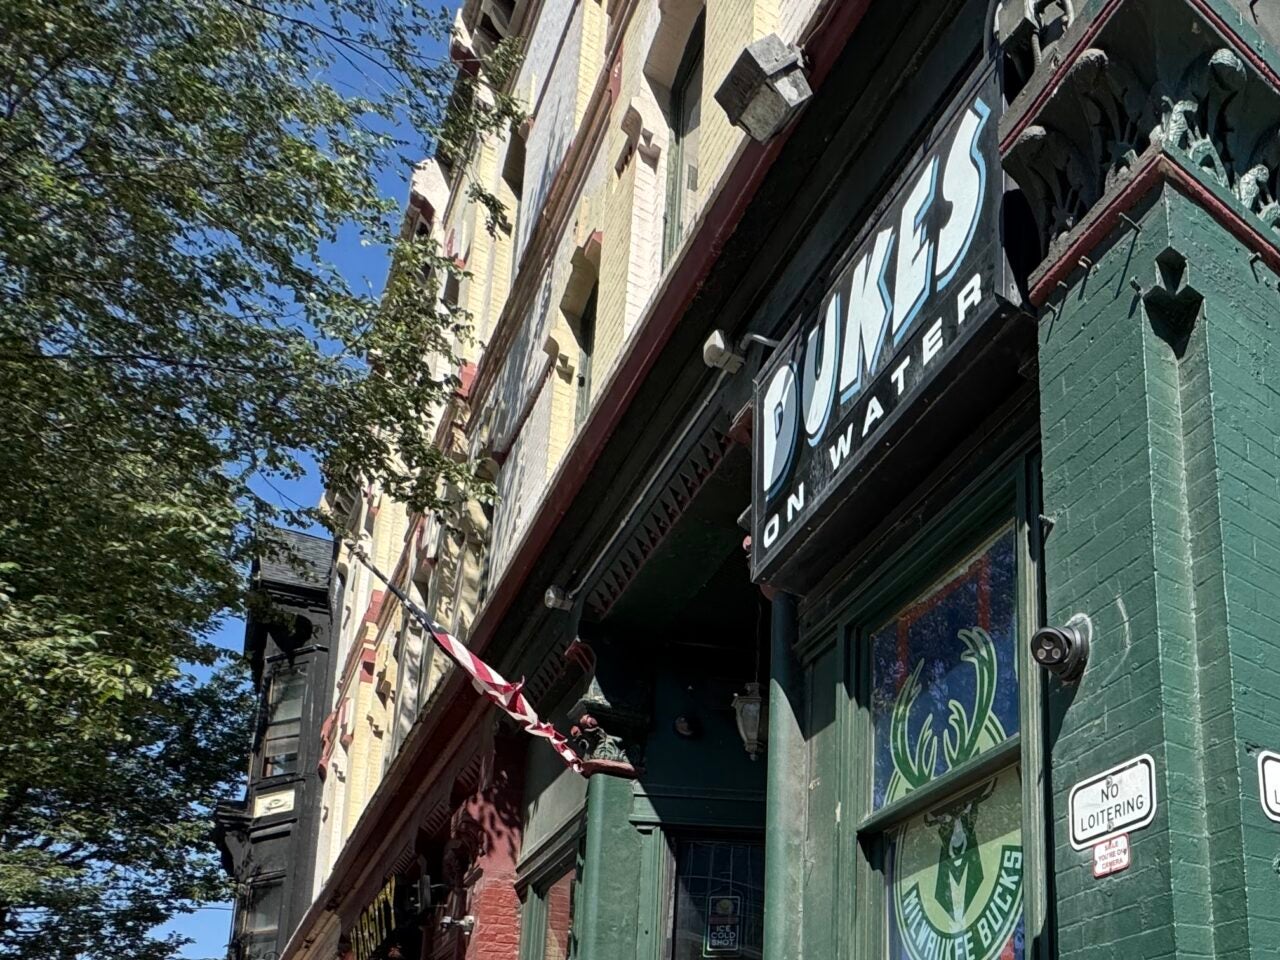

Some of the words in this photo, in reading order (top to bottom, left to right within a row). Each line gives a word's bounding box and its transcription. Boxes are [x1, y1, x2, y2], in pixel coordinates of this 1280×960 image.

[763, 97, 992, 502] DUKES
[763, 483, 805, 549] ON
[829, 272, 982, 471] WATER
[1101, 783, 1119, 803] NO
[1080, 794, 1144, 832] LOITERING
[976, 850, 1023, 949] BUCKS
[710, 931, 736, 939] COLD
[716, 924, 731, 932] ICE
